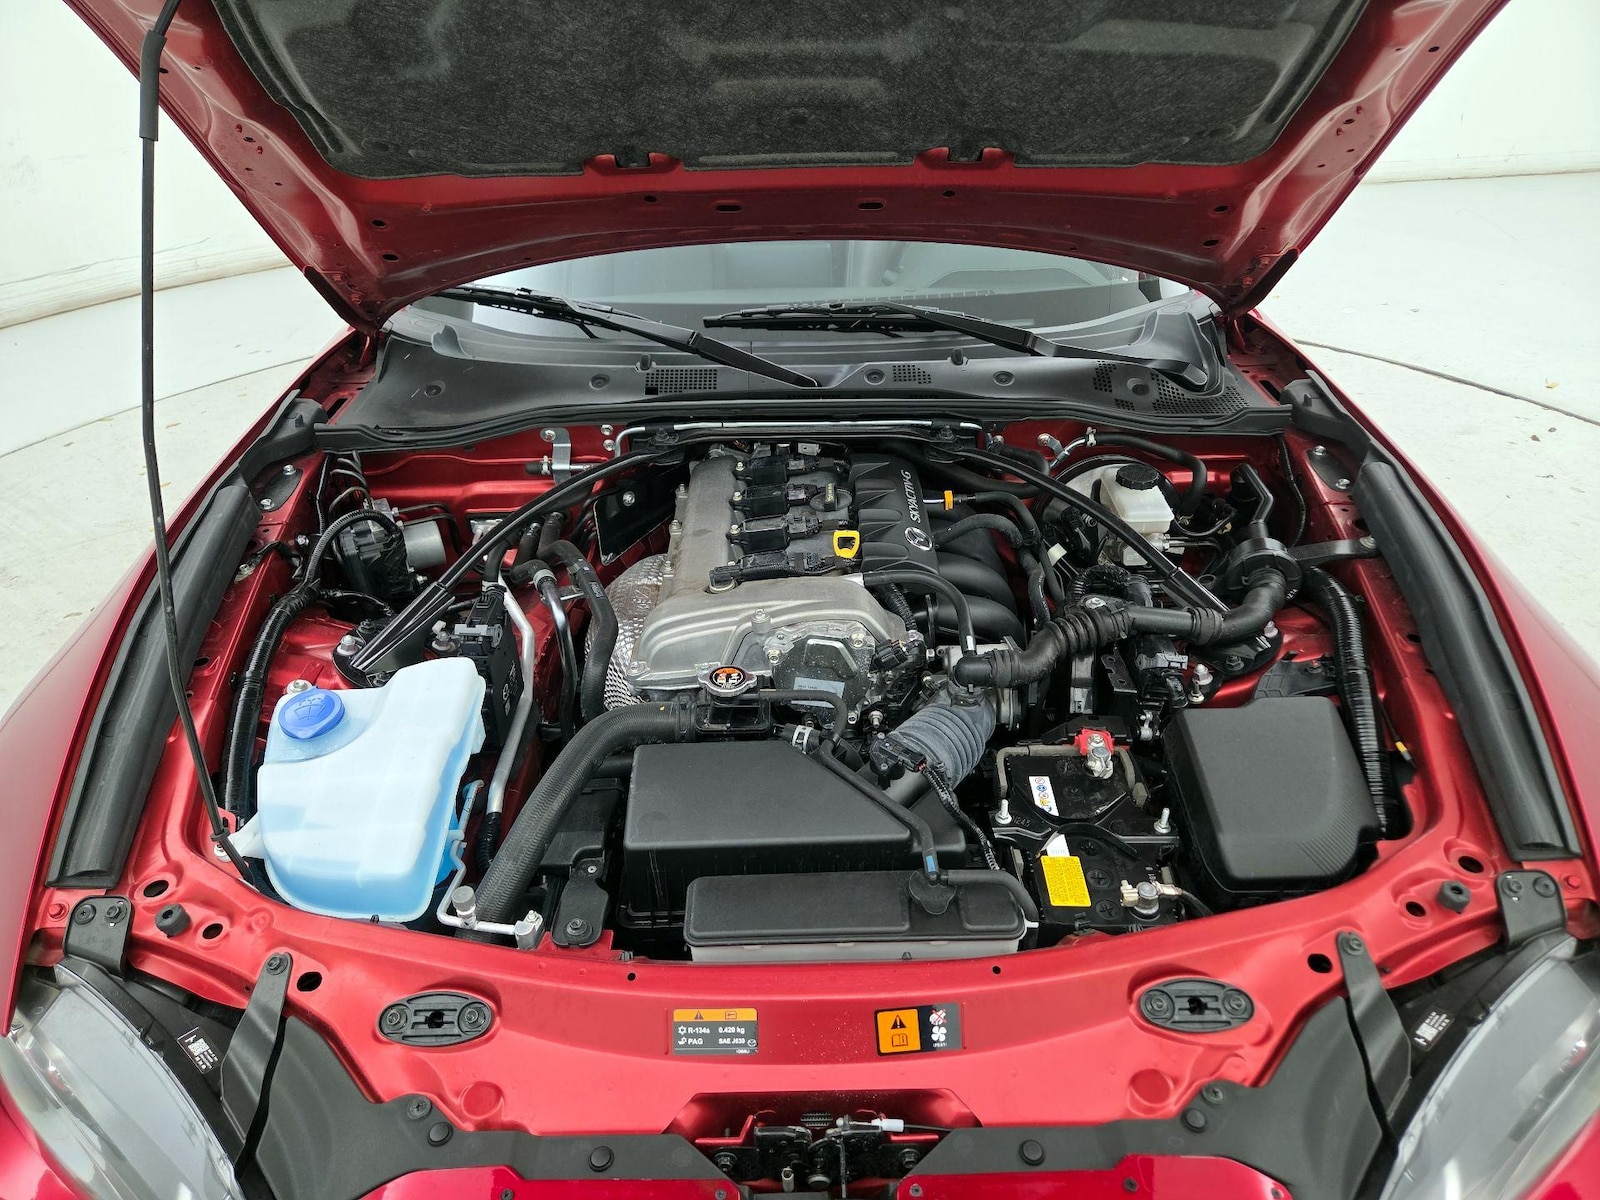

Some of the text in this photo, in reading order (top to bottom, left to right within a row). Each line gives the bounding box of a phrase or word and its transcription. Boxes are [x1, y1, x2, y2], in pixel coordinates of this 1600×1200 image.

[718, 1026, 745, 1035] 0.420 kg
[718, 1037, 731, 1045] SAE
